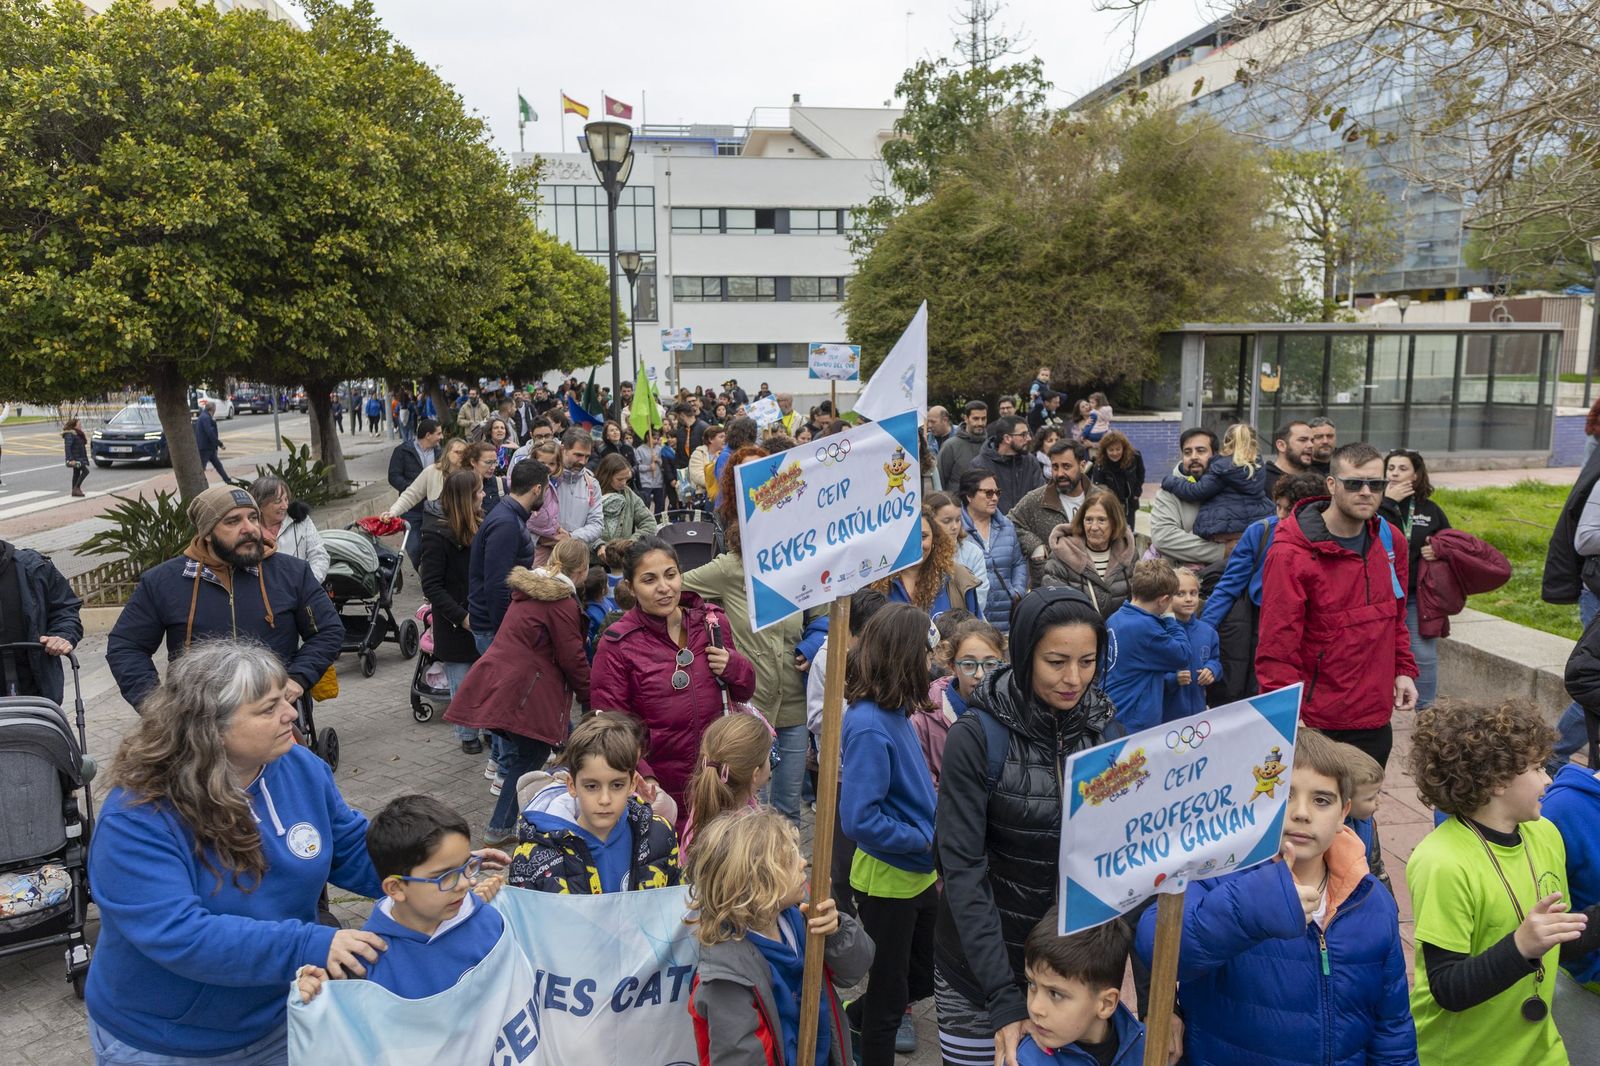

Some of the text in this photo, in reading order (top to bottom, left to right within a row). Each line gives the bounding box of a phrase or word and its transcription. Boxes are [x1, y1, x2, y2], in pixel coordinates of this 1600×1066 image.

[817, 477, 851, 508] CEIP
[756, 491, 916, 574] REYES CATÓLICOS
[1163, 756, 1209, 791] CEIP
[1094, 801, 1257, 879] TIERNO GALVÁN
[1125, 784, 1233, 843] PROFESOR
